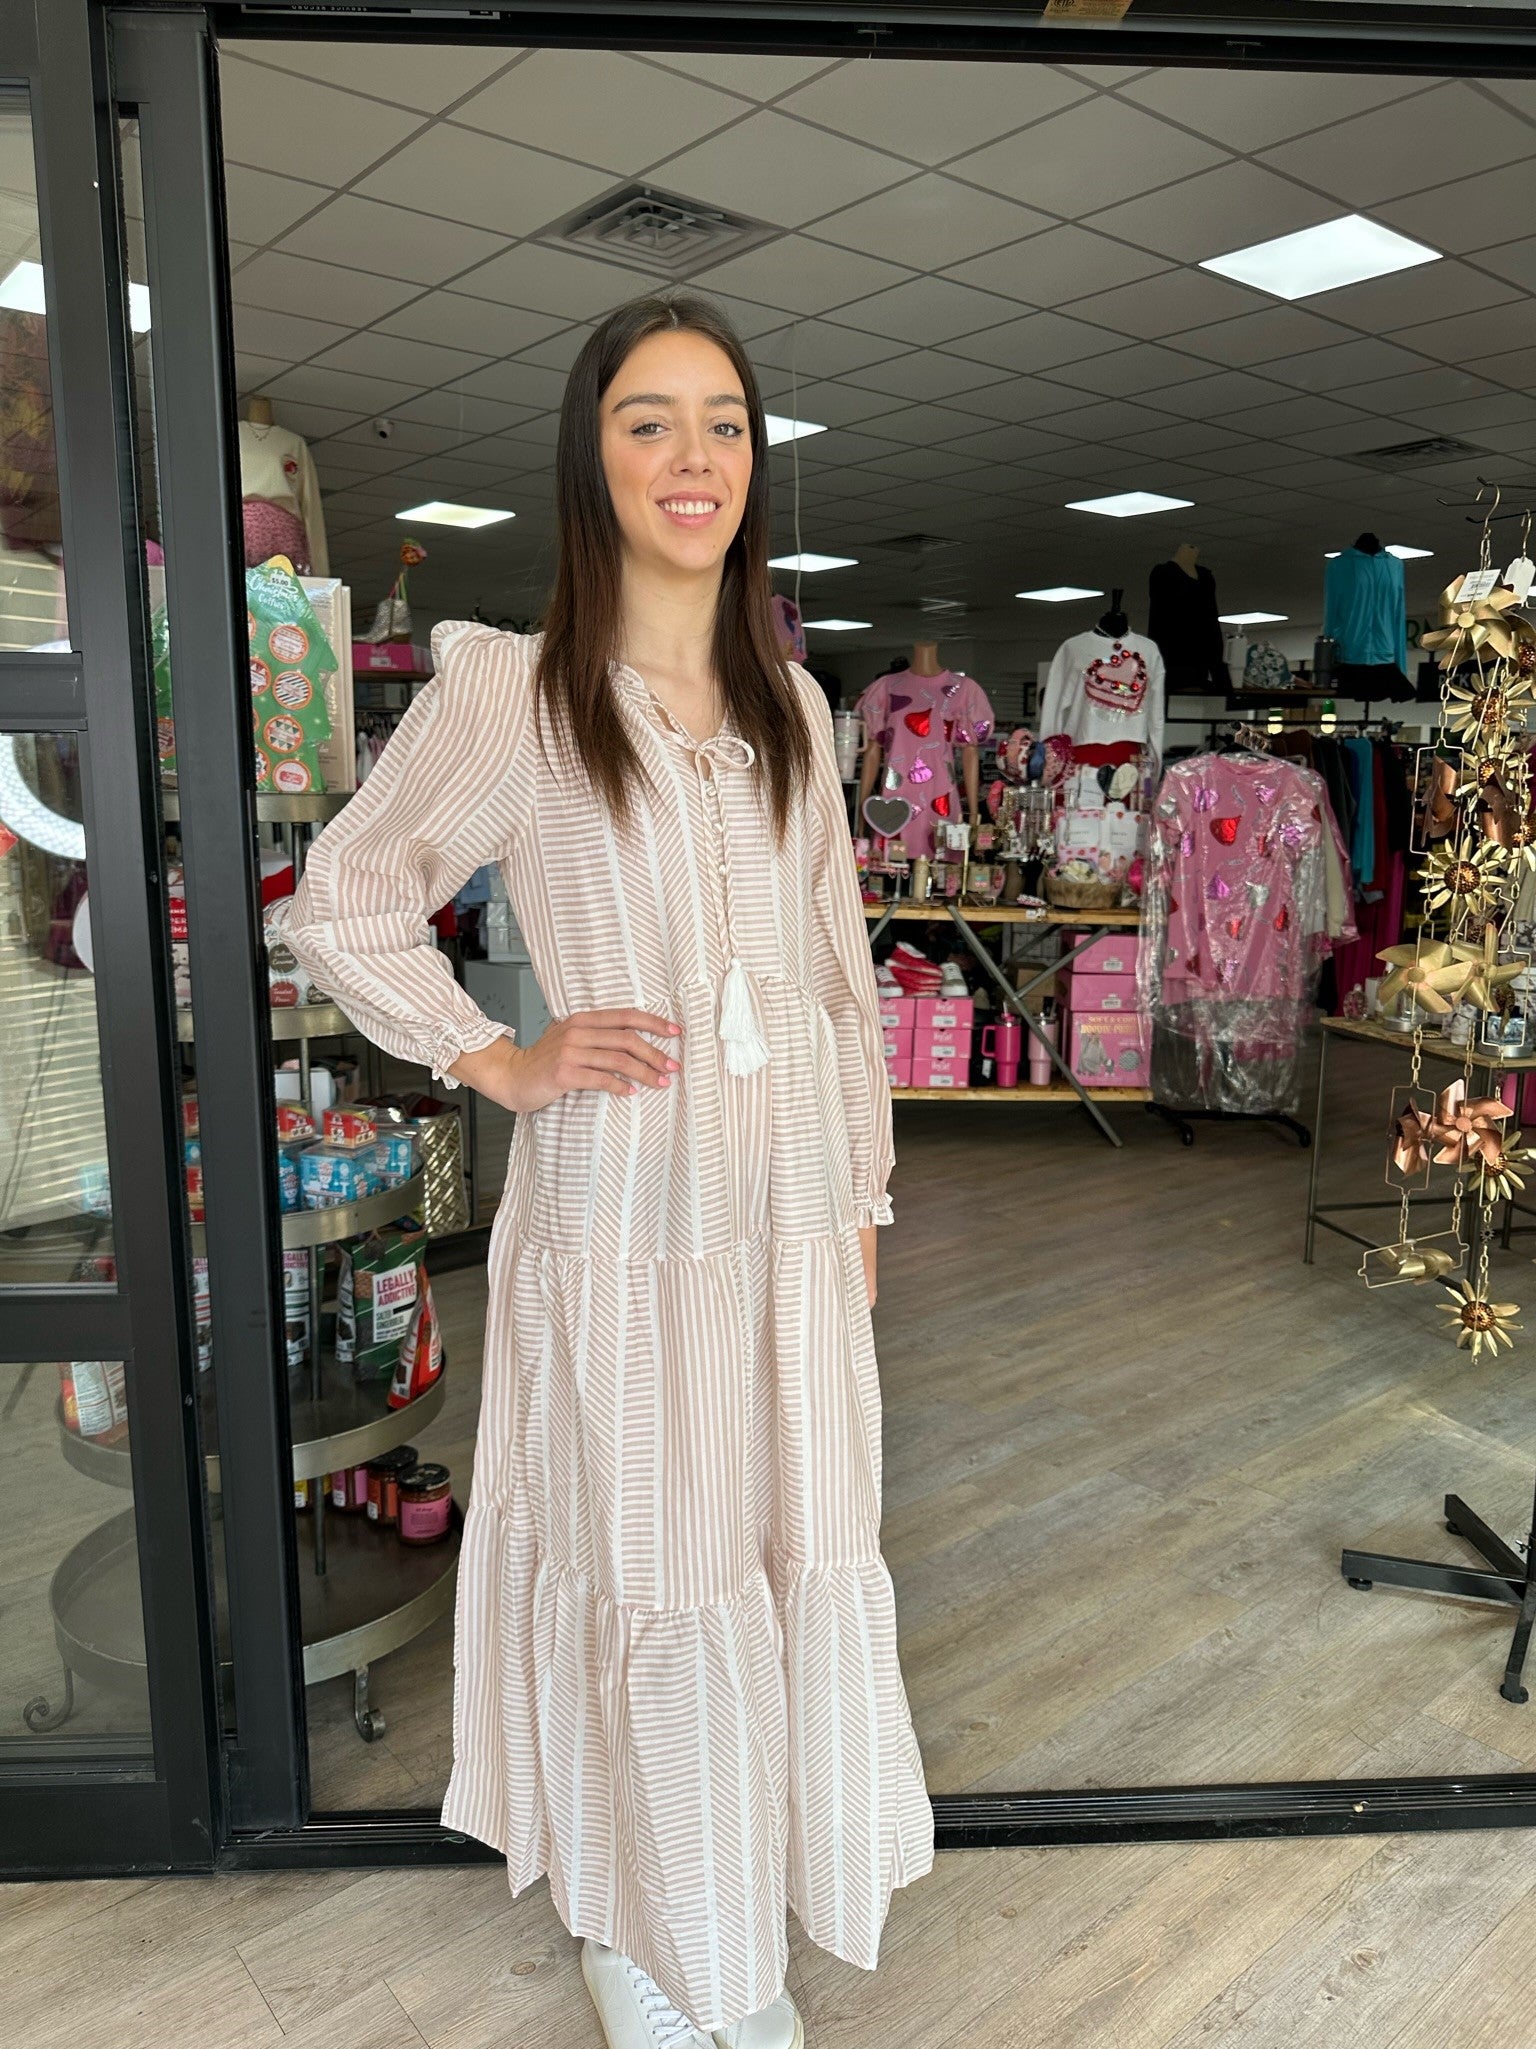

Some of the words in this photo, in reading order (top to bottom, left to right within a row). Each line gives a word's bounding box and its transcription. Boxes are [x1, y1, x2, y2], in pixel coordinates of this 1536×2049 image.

[272, 577, 288, 586] $5.00
[376, 1269, 415, 1294] LEGALLY
[378, 1284, 416, 1307] ADDICTIVE
